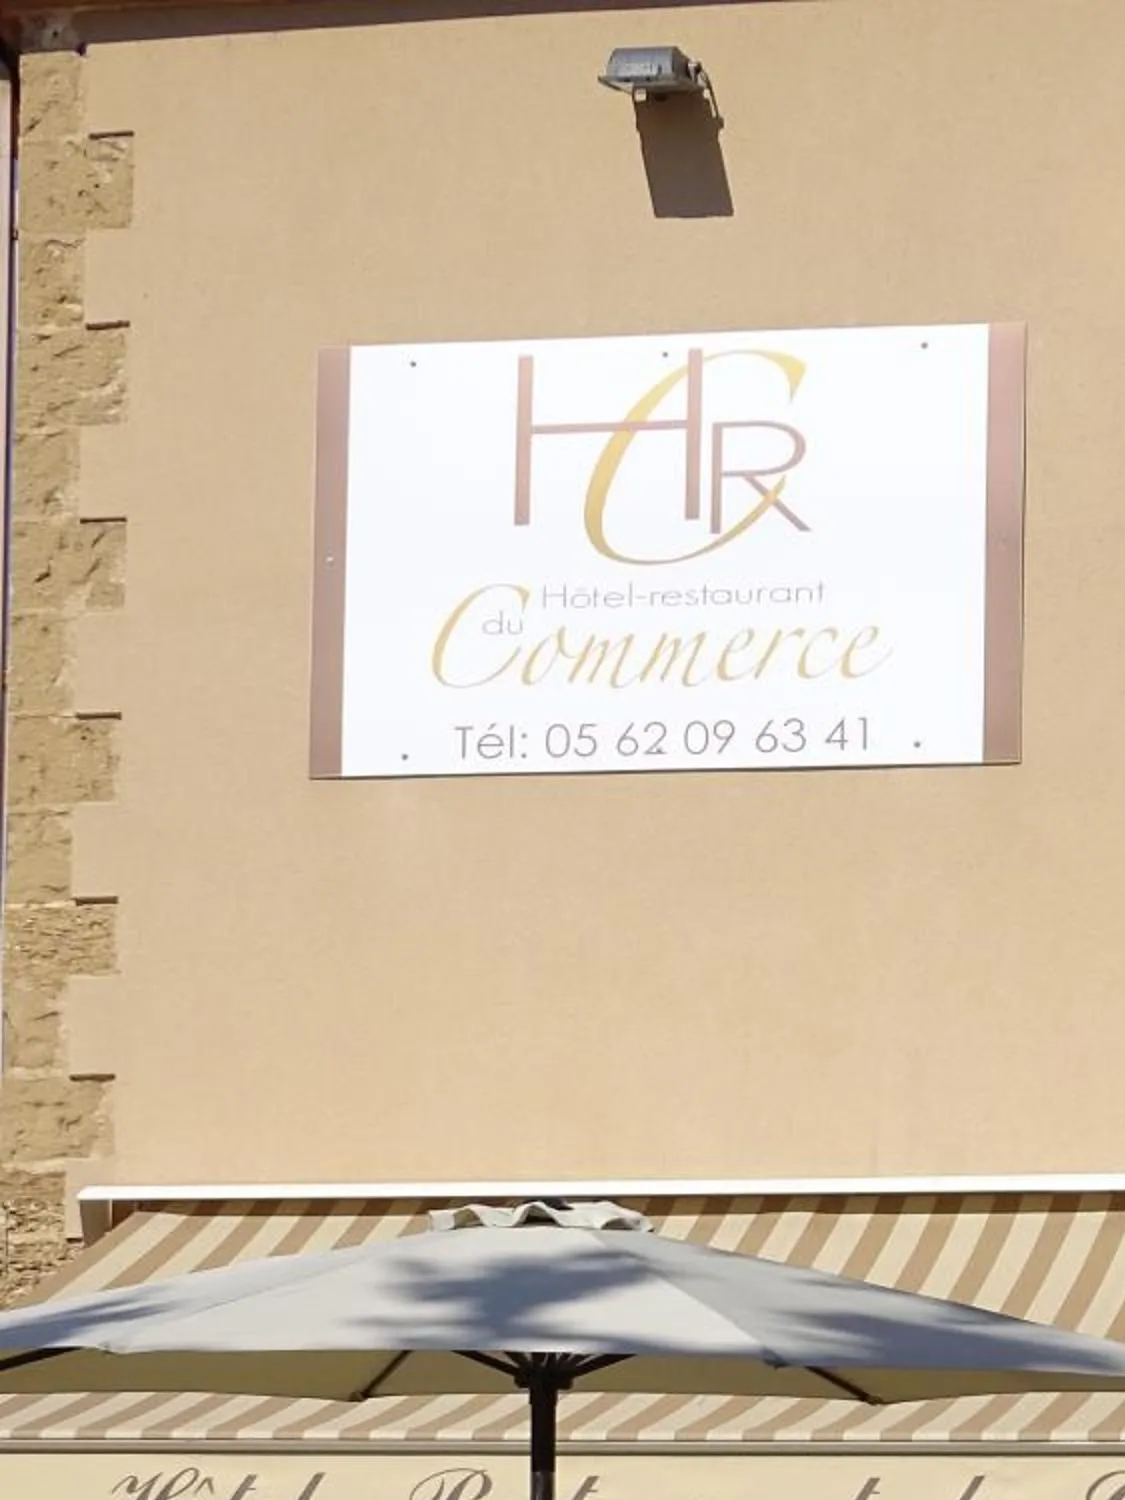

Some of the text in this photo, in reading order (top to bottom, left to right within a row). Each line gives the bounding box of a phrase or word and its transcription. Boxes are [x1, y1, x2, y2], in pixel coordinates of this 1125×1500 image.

[542, 581, 825, 609] Hôtel-restaurant
[431, 583, 893, 689] du Commerce
[454, 716, 869, 759] Tél: 05 62 09 63 41
